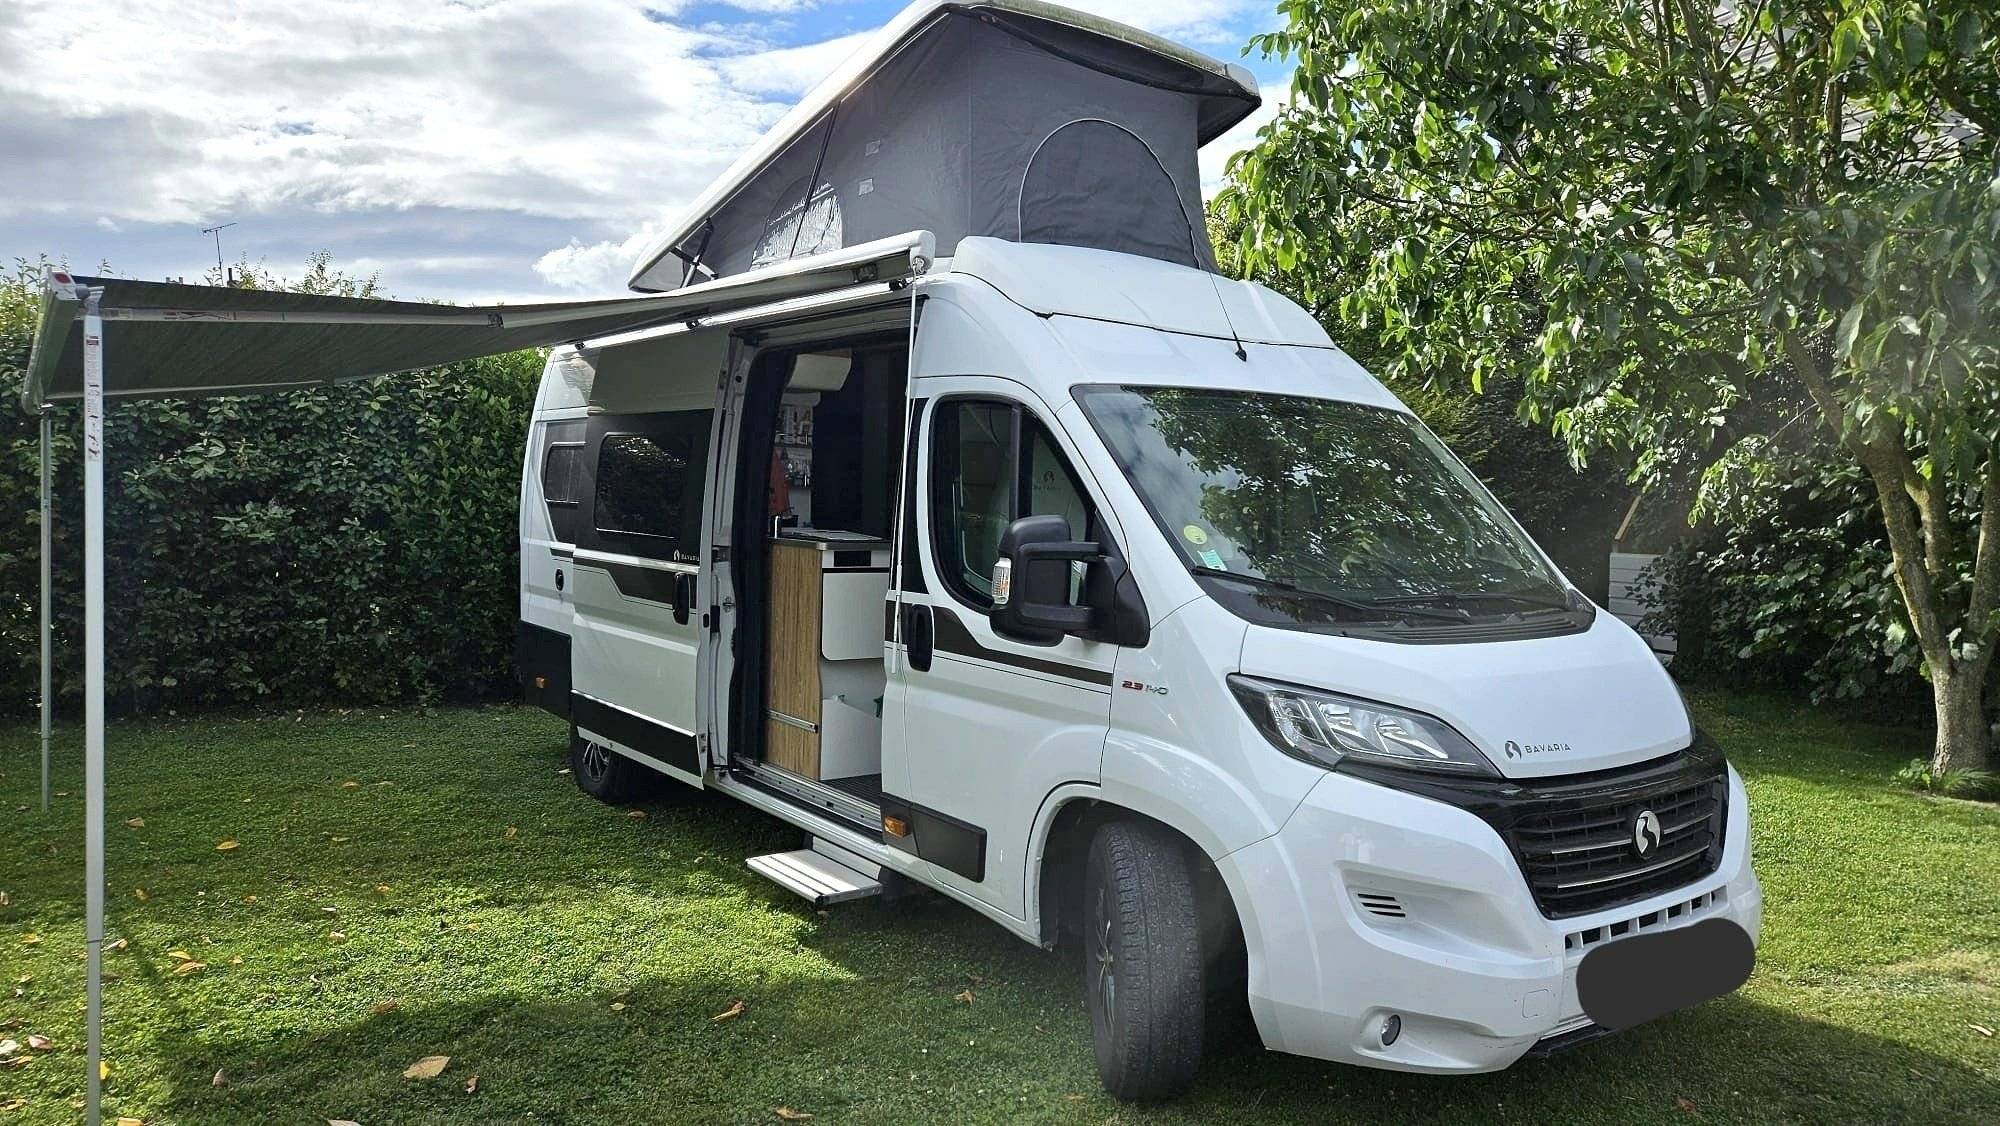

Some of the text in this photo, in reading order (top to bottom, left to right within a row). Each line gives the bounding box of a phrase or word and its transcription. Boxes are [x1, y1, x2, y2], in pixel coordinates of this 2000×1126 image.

[1121, 680, 1168, 695] 2.3 140
[1524, 743, 1571, 754] BAVARIA
